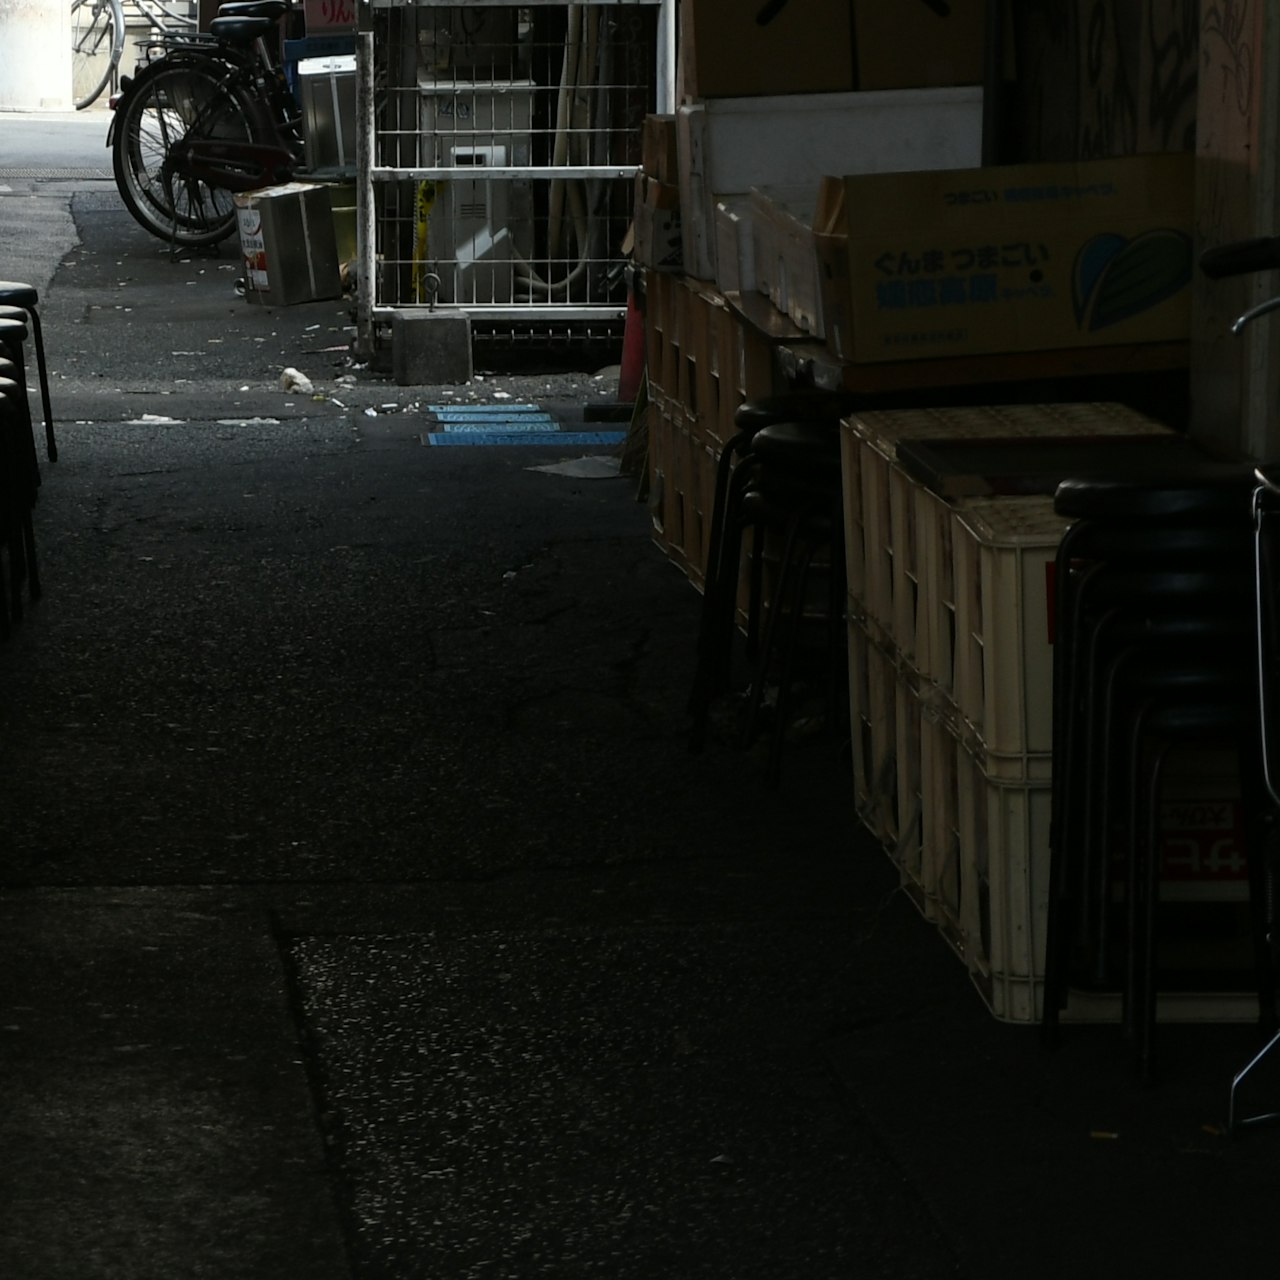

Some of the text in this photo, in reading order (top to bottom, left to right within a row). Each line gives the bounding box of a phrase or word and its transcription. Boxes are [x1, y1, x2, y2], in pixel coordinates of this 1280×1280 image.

[873, 242, 1050, 276] ぐんま つまごい
